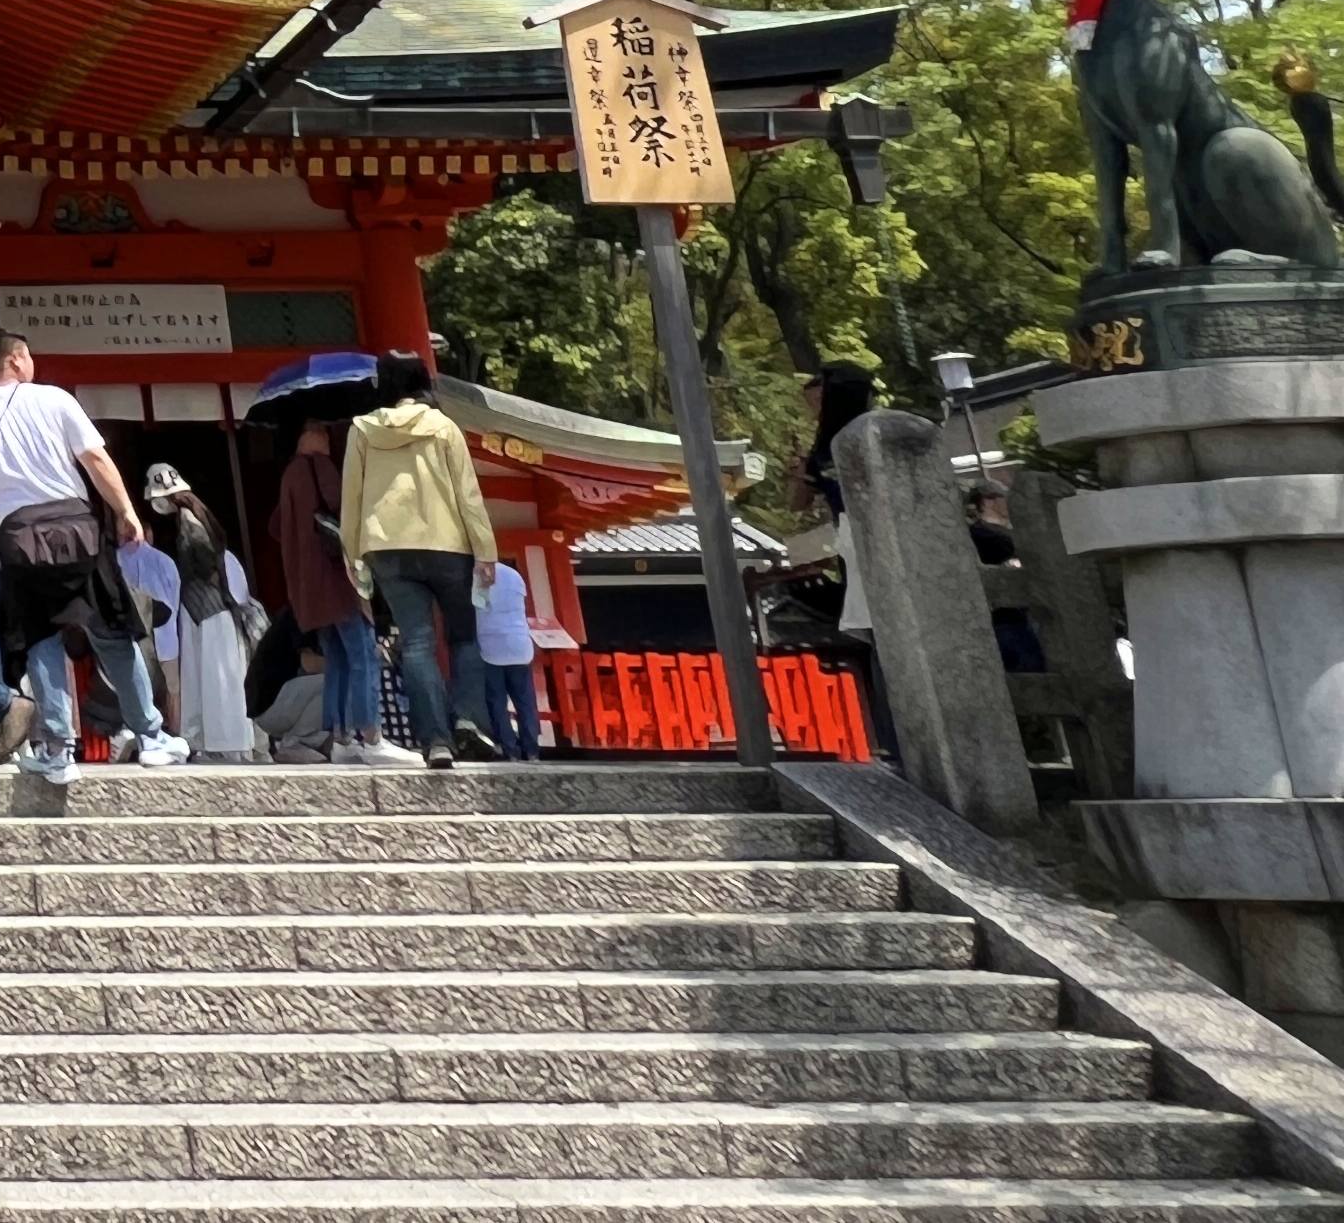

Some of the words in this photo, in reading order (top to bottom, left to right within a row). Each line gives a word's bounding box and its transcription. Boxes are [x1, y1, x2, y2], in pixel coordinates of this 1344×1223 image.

[610, 16, 677, 169] 稲荷祭
[108, 313, 219, 327] はずしております
